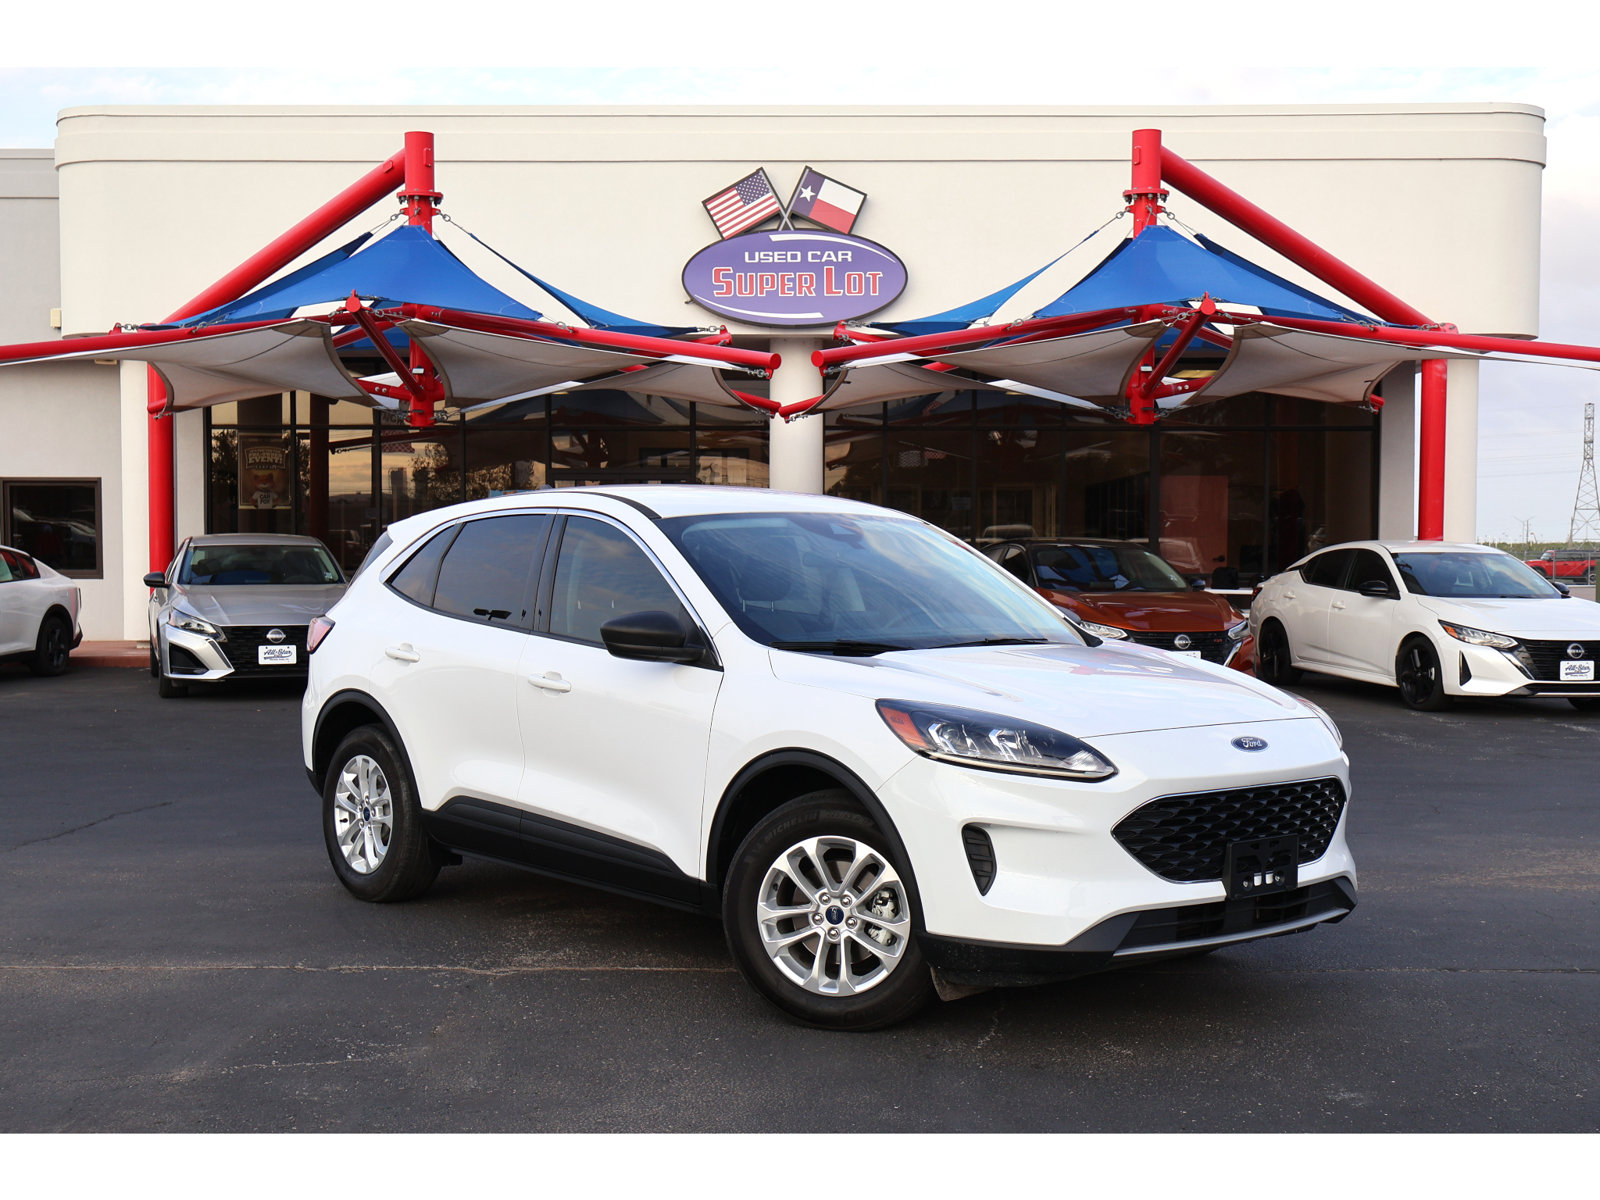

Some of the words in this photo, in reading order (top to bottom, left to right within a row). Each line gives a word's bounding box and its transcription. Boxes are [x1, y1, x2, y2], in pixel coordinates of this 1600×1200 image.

[744, 250, 801, 263] USED
[807, 250, 852, 262] CAR
[711, 266, 817, 297] SUPER
[823, 265, 883, 297] LOT
[1241, 737, 1263, 748] Ford
[765, 812, 818, 842] MICHELIN
